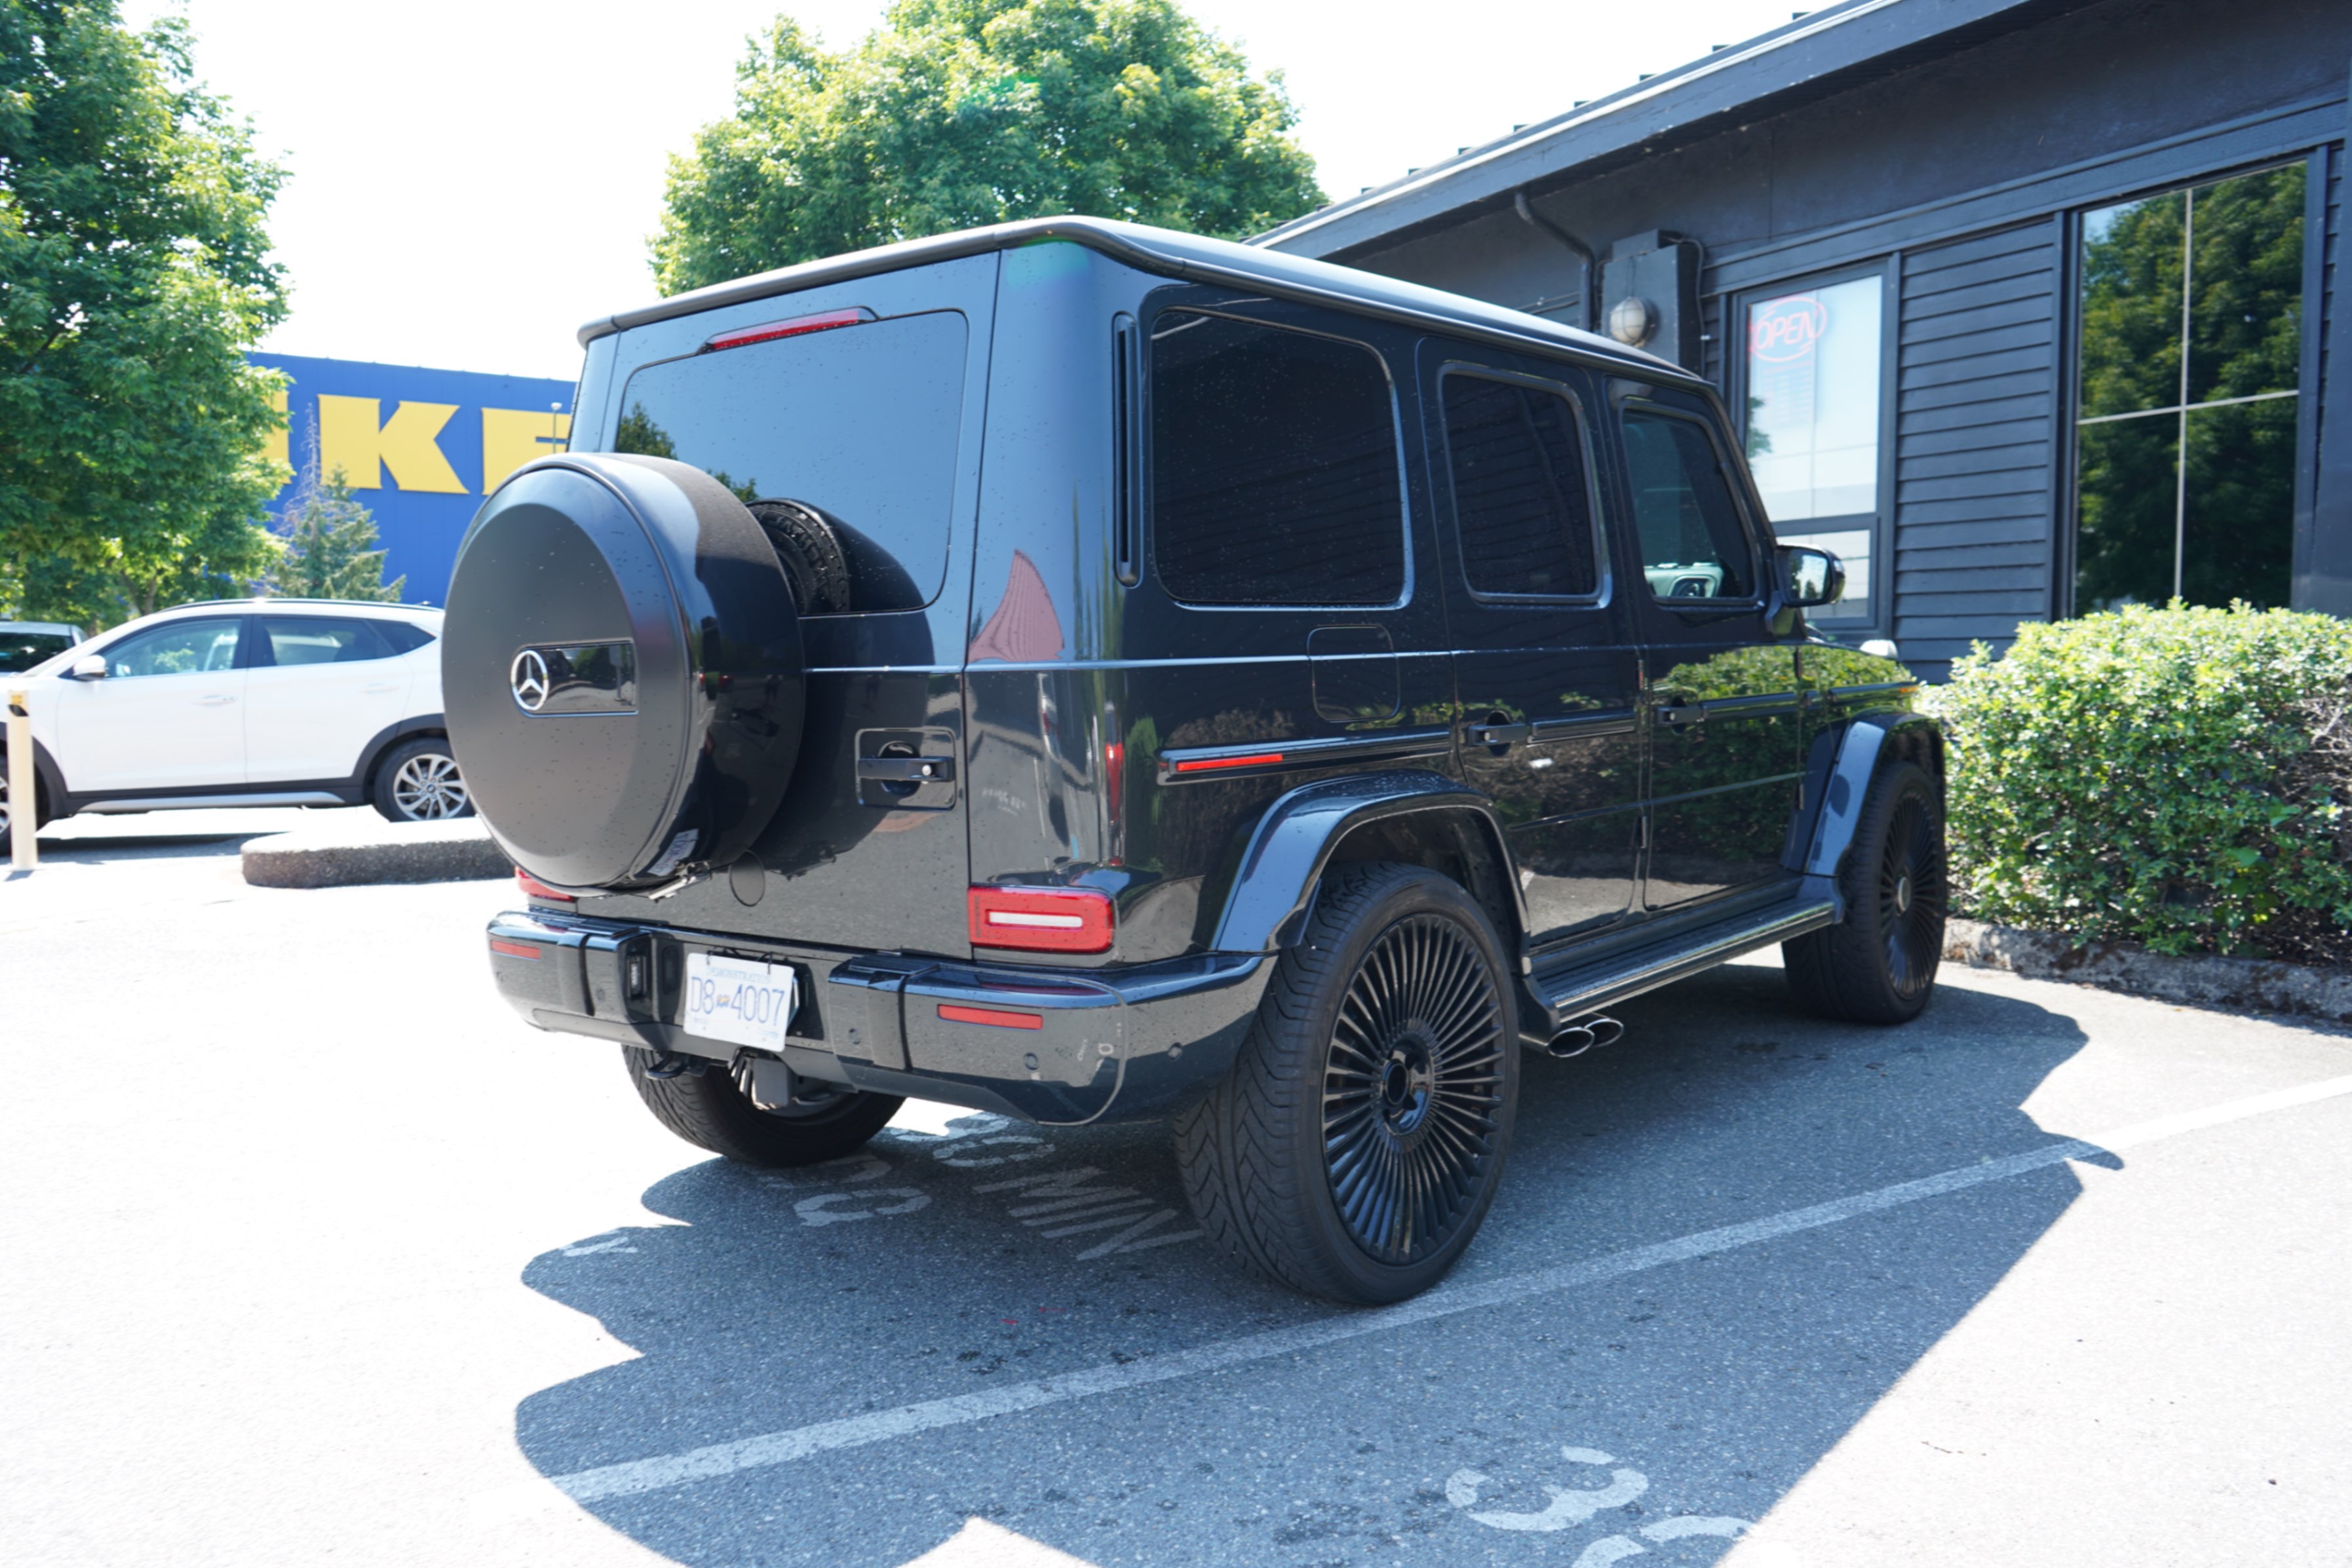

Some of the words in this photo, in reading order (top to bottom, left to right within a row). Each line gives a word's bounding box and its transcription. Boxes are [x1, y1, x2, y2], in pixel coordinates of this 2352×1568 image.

[1753, 311, 1815, 351] OPEN
[690, 976, 716, 1015] D8
[730, 984, 786, 1027] 4007
[973, 1166, 1205, 1261] MIN
